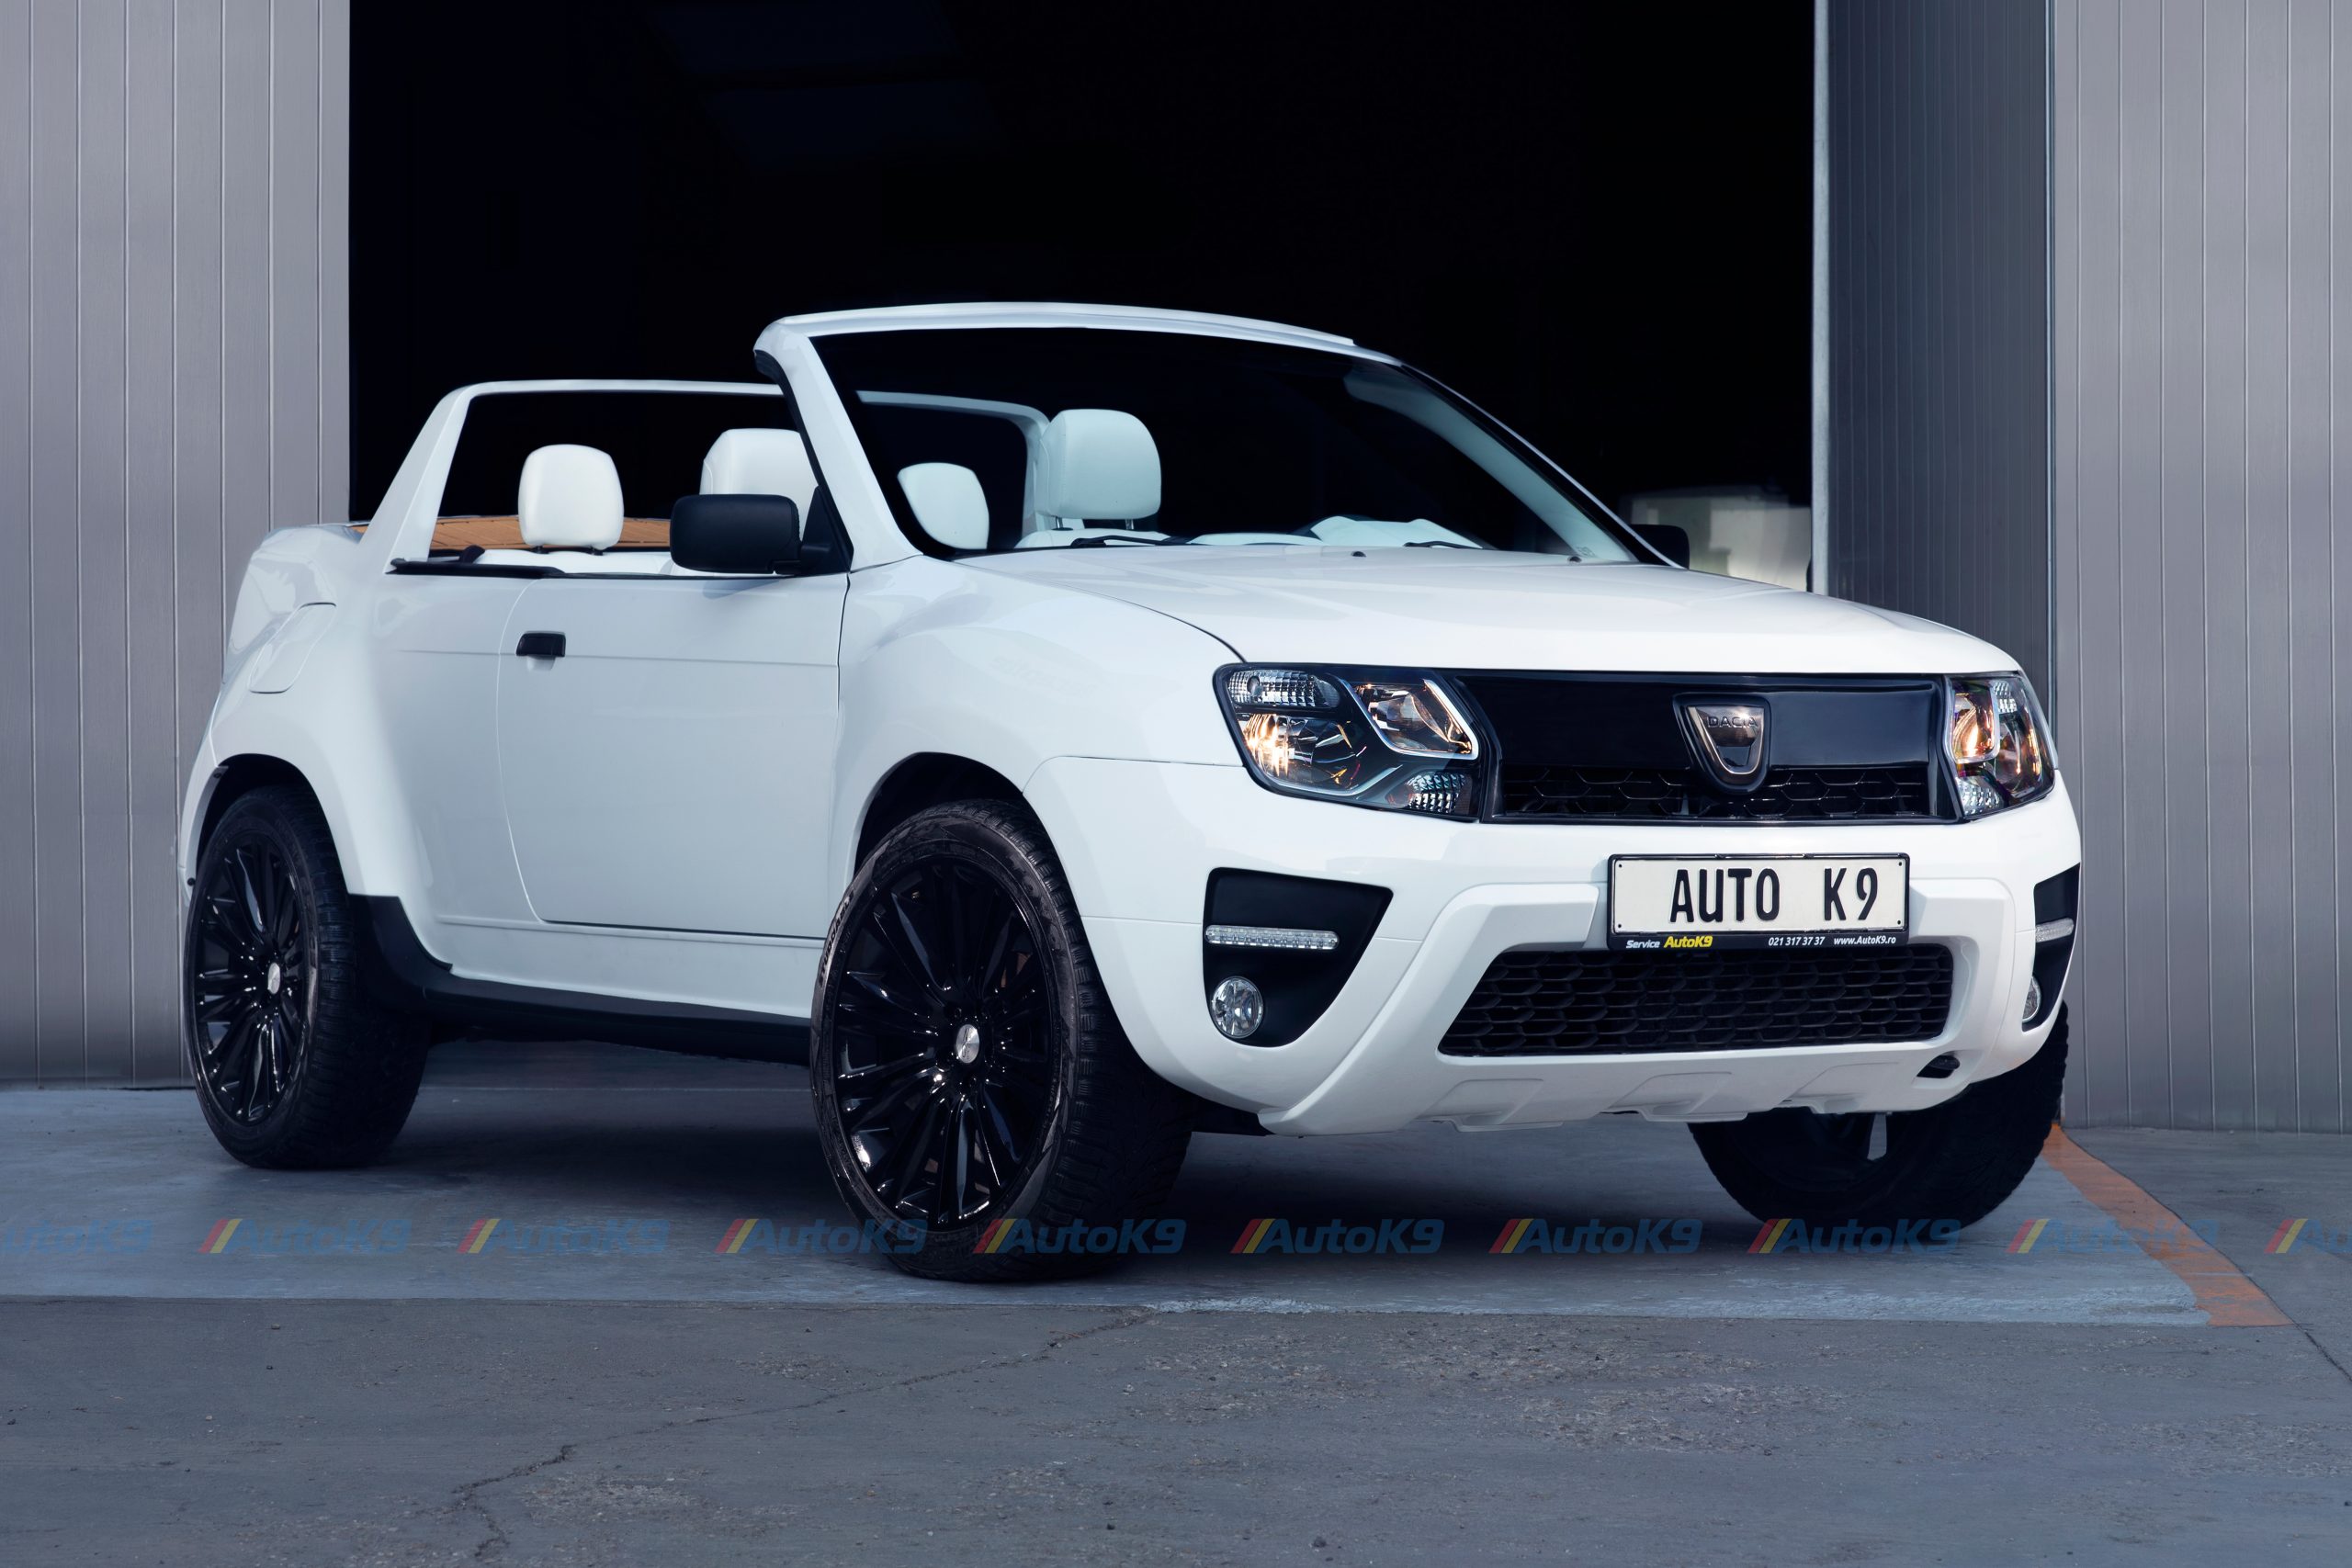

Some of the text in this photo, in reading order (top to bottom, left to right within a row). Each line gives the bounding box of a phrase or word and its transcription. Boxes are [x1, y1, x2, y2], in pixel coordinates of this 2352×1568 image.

[1706, 716, 1758, 728] DACIA
[1669, 867, 1879, 922] AUTO K9
[1625, 935, 1713, 949] Service AutoK9
[1768, 936, 1826, 946] 021 317 37 37
[1834, 935, 1896, 945] www.AutoK9.ro
